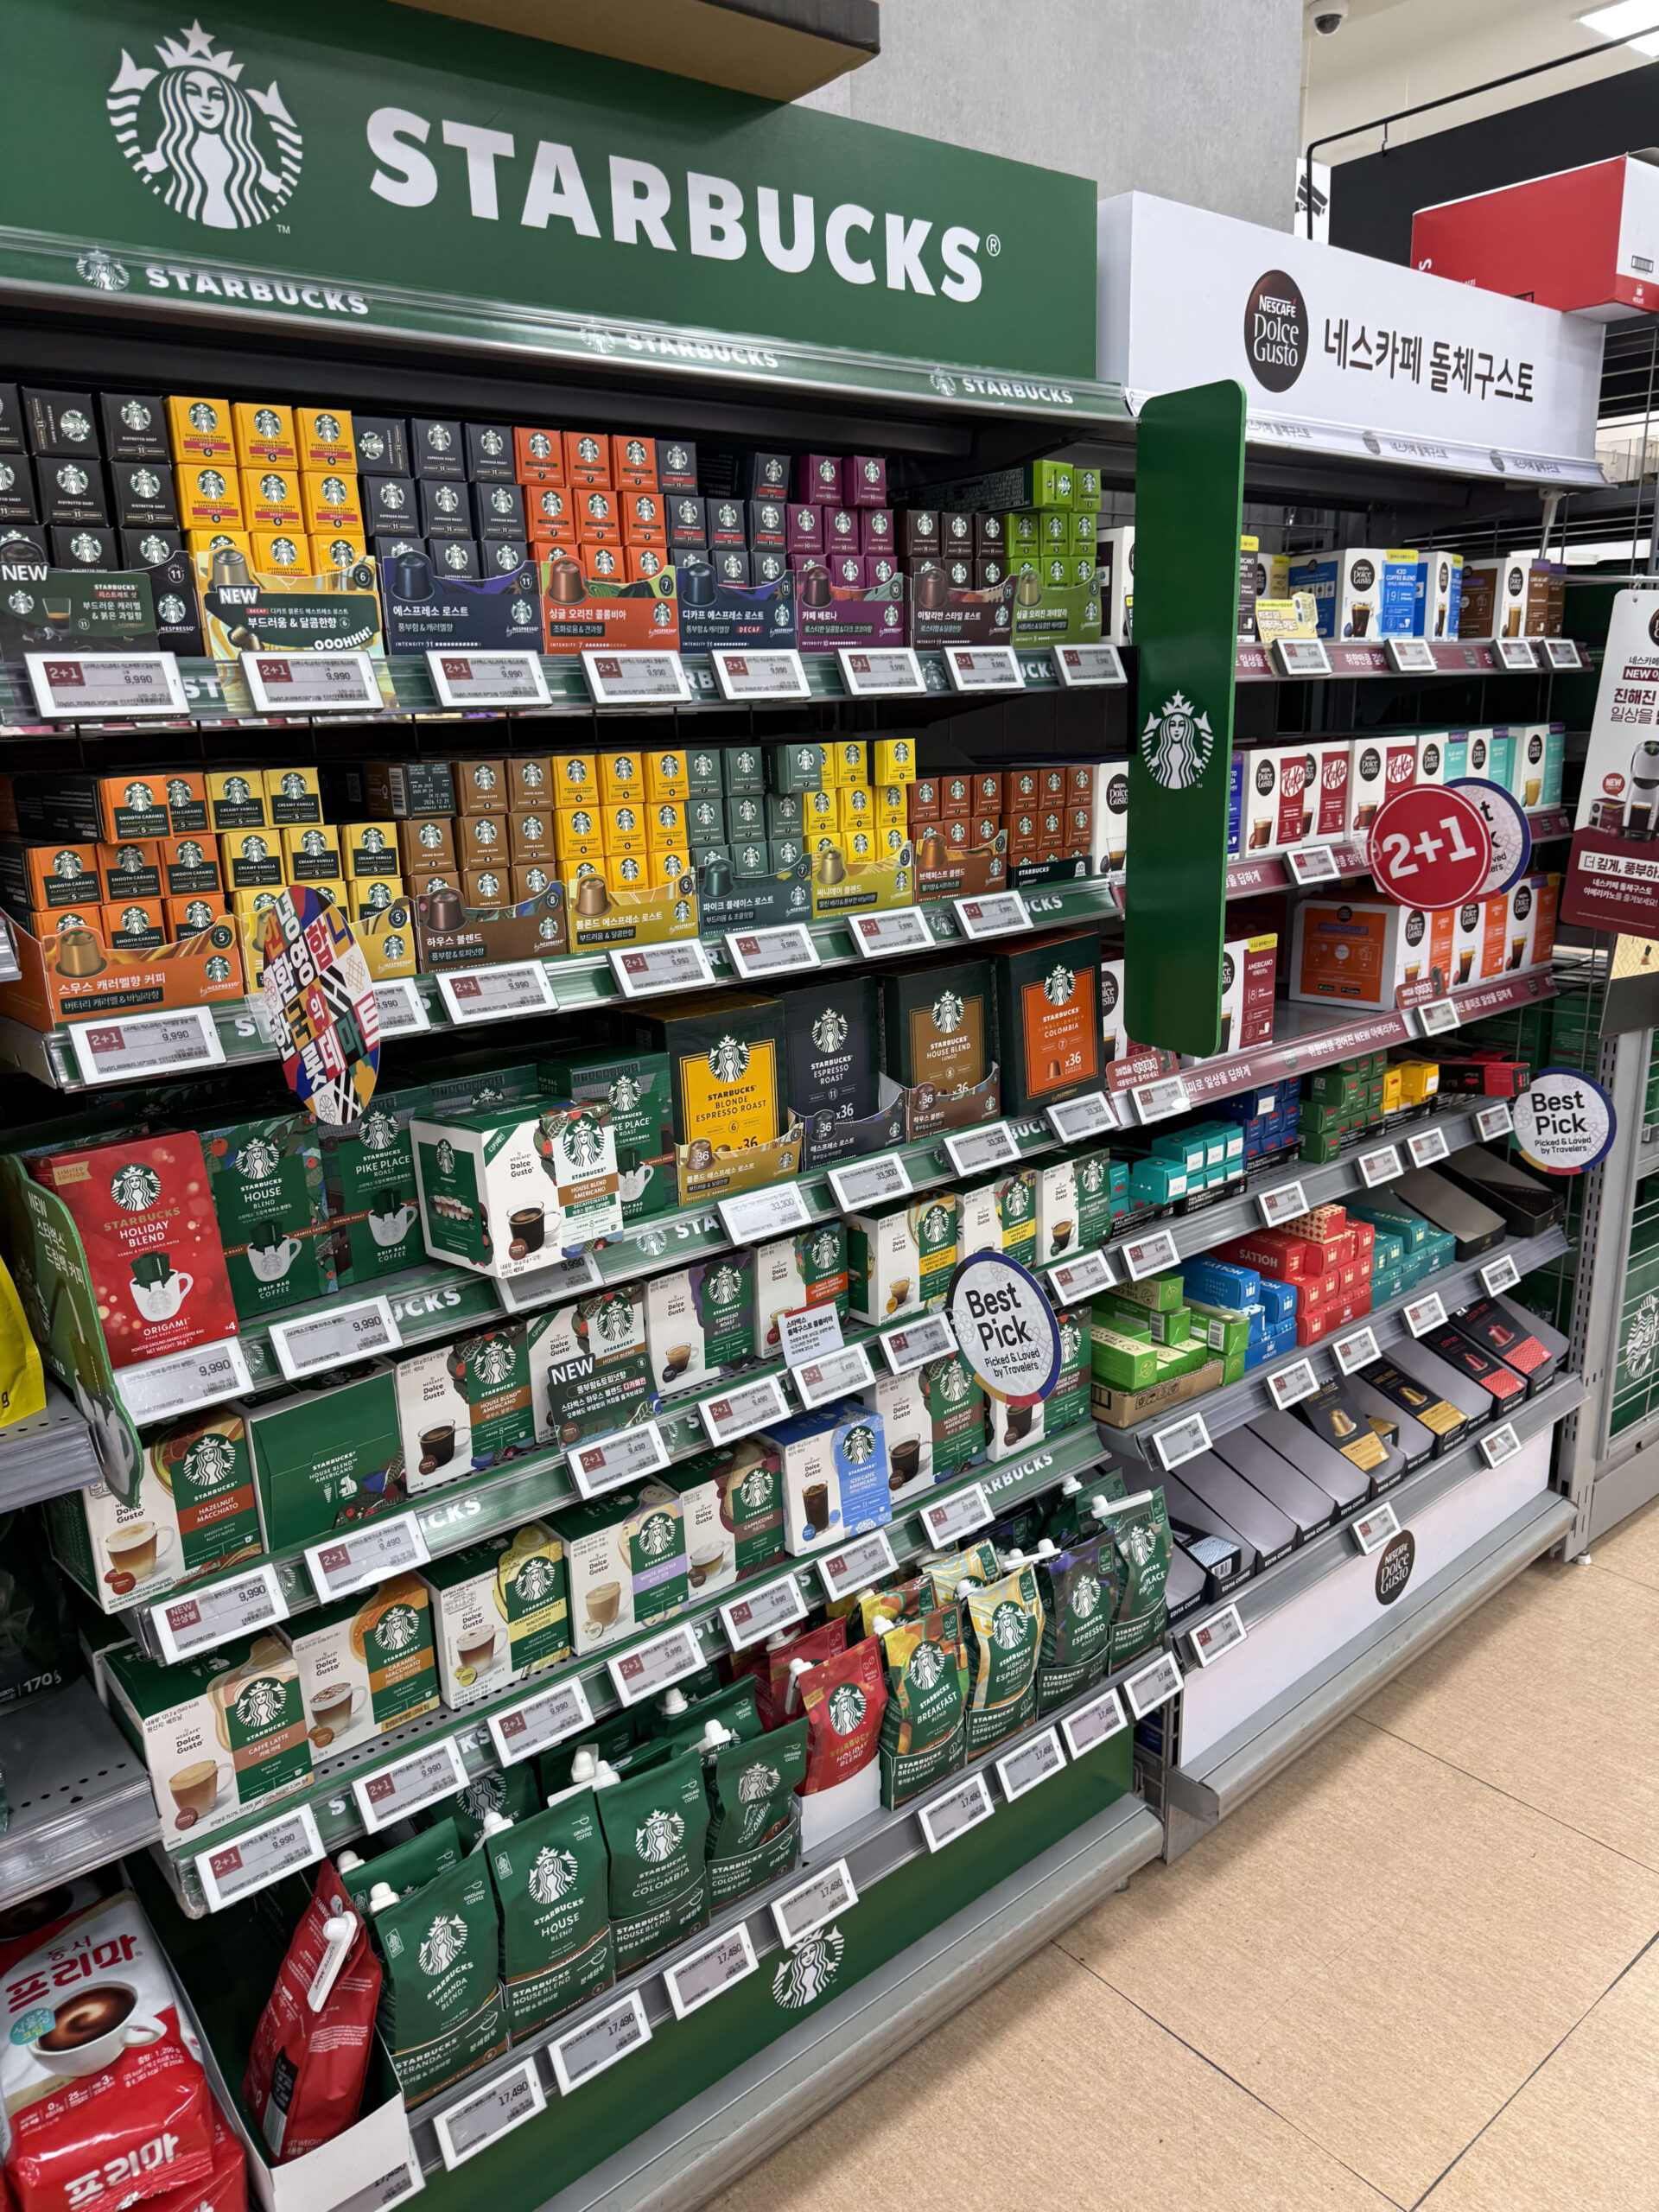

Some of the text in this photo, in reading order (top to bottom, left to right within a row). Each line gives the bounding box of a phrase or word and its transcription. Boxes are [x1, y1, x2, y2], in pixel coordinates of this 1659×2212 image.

[146, 265, 369, 315] STARBUCKS
[1259, 294, 1296, 318] NESCAFÉ
[1254, 313, 1299, 346] Dolce
[625, 332, 778, 368] STARBUCKS
[1253, 338, 1298, 368] Gusto
[1324, 318, 1534, 404] 네스카페 돌체구스토
[963, 377, 1074, 404] STARBUCKS
[2, 565, 48, 582] NEW
[219, 588, 257, 604] NEW
[83, 601, 114, 612] 부드러운
[393, 606, 469, 618] 에스프레소 로스트
[549, 609, 566, 620] 싱글
[568, 609, 593, 620] 오리진
[248, 616, 287, 629] 부드러움
[300, 616, 336, 628] 달콤한향
[802, 611, 816, 620] 카페
[49, 666, 79, 679] 2+1
[262, 664, 288, 677] 2+1
[326, 671, 351, 681] 9,990
[1624, 668, 1649, 679] NEW
[124, 675, 153, 684] 9,990
[1614, 688, 1656, 704] 진해진
[1611, 706, 1653, 723] 일상을
[1605, 778, 1622, 787] NEW
[1382, 816, 1477, 880] 2+1
[1585, 855, 1595, 869] 더
[703, 902, 724, 912] 파이크
[426, 932, 483, 946] 하우스 블렌드
[59, 974, 166, 995] 스무스 캐러멜향 커피
[1045, 1024, 1079, 1038] COLOMBIA
[926, 1043, 971, 1058] HOUSE BLEND
[1065, 1052, 1081, 1068] x36
[813, 1064, 849, 1078] ESPRESSO
[820, 1073, 843, 1084] ROAST
[715, 1096, 747, 1109] BLONDE
[1530, 1090, 1584, 1114] Best
[696, 1100, 766, 1122] ESPRESSO ROAST
[836, 1103, 854, 1119] x36
[1535, 1111, 1586, 1135] Pick
[1535, 1137, 1558, 1147] Picked
[1567, 1136, 1592, 1145] Loved
[1541, 1144, 1587, 1154] by Travelers
[356, 1154, 410, 1175] PIKE PLACE
[875, 1166, 898, 1181] 33,300
[244, 1186, 282, 1202] HOUSE
[571, 1179, 607, 1192] HOUSE BLEND
[574, 1187, 606, 1199] AMERICANO
[28, 1192, 48, 1217] NEW
[771, 1197, 795, 1211] 33,300
[119, 1220, 169, 1240] HOLIDAY
[129, 1231, 165, 1248] BLEND
[257, 1281, 290, 1294] DRIP BAG
[259, 1285, 290, 1300] COFFEE
[965, 1283, 1021, 1319] Best
[143, 1318, 188, 1336] ORIGAMI
[226, 1321, 236, 1331] x4
[716, 1313, 739, 1324] ESPRESSO
[977, 1315, 1033, 1351] Pick
[985, 1349, 1039, 1369] Picked & Loved
[551, 1357, 593, 1385] NEW
[994, 1361, 1039, 1377] by Travelers
[562, 1399, 585, 1412] 스타벅스
[586, 1393, 604, 1402] 하우스
[196, 1502, 239, 1523] MACCHIATO
[199, 1497, 234, 1517] HAZELNUT
[1381, 1552, 1409, 1578] Dolce
[1380, 1566, 1409, 1595] Gusto
[387, 1657, 422, 1674] CARAMEL
[917, 1692, 957, 1725] BREAKFAST
[961, 1790, 981, 1808] 17,490
[632, 1868, 690, 1897] COLOMBIA
[541, 1912, 581, 1937] HOUSE
[48, 1936, 92, 1961] 동서
[717, 1941, 743, 1966] 17,490
[6, 1934, 137, 2012] 프리마
[435, 1977, 467, 2006] VERANDA
[64, 2133, 179, 2211] 프리마
